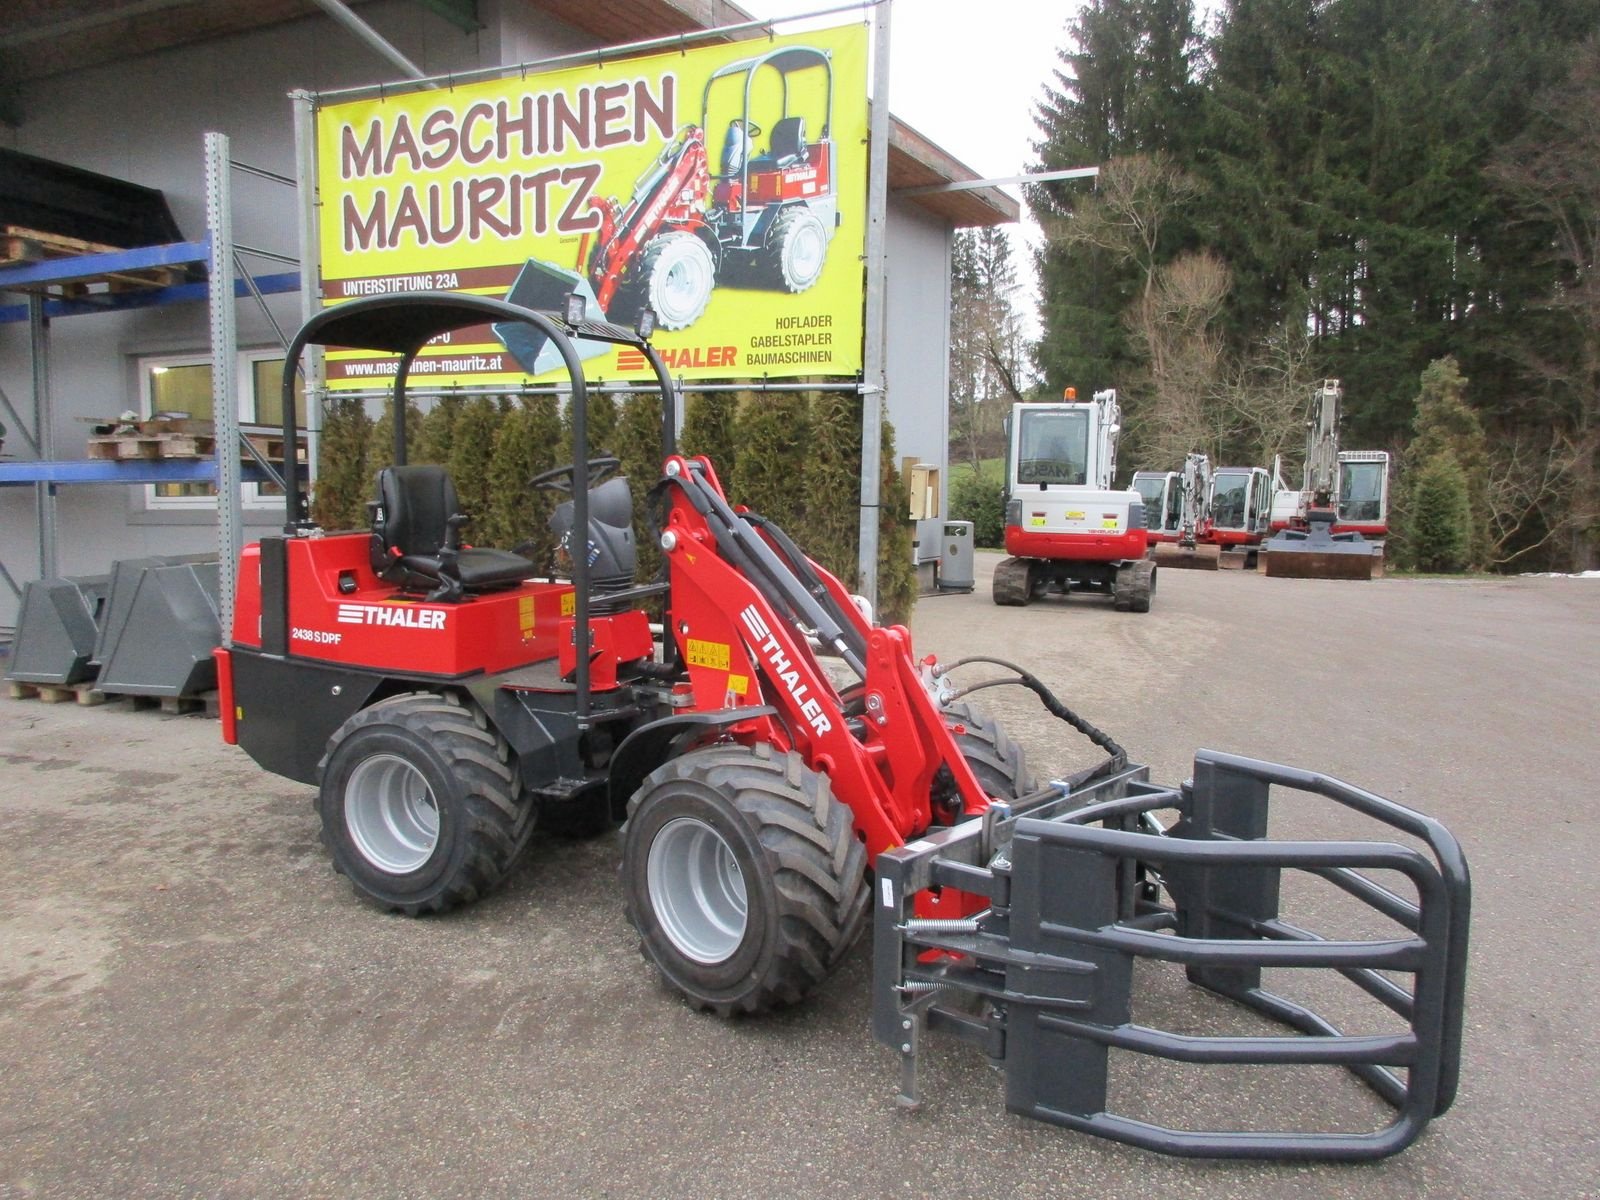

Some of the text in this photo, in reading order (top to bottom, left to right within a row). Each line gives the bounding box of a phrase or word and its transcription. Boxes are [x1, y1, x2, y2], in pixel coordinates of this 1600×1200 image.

[342, 75, 675, 179] MASCHINEN
[343, 164, 602, 251] MAURITZ
[343, 273, 459, 296] UNTERSTIFTUNG 23A
[776, 315, 833, 330] HOFLADER
[750, 333, 833, 349] GABELSTAPLER
[345, 355, 503, 376] www.masinen-mauritz.at
[746, 350, 833, 366] BAUMASCHINEN
[364, 606, 447, 630] THALER
[292, 627, 342, 645] 2438 S DPF
[761, 633, 832, 738] THALER
